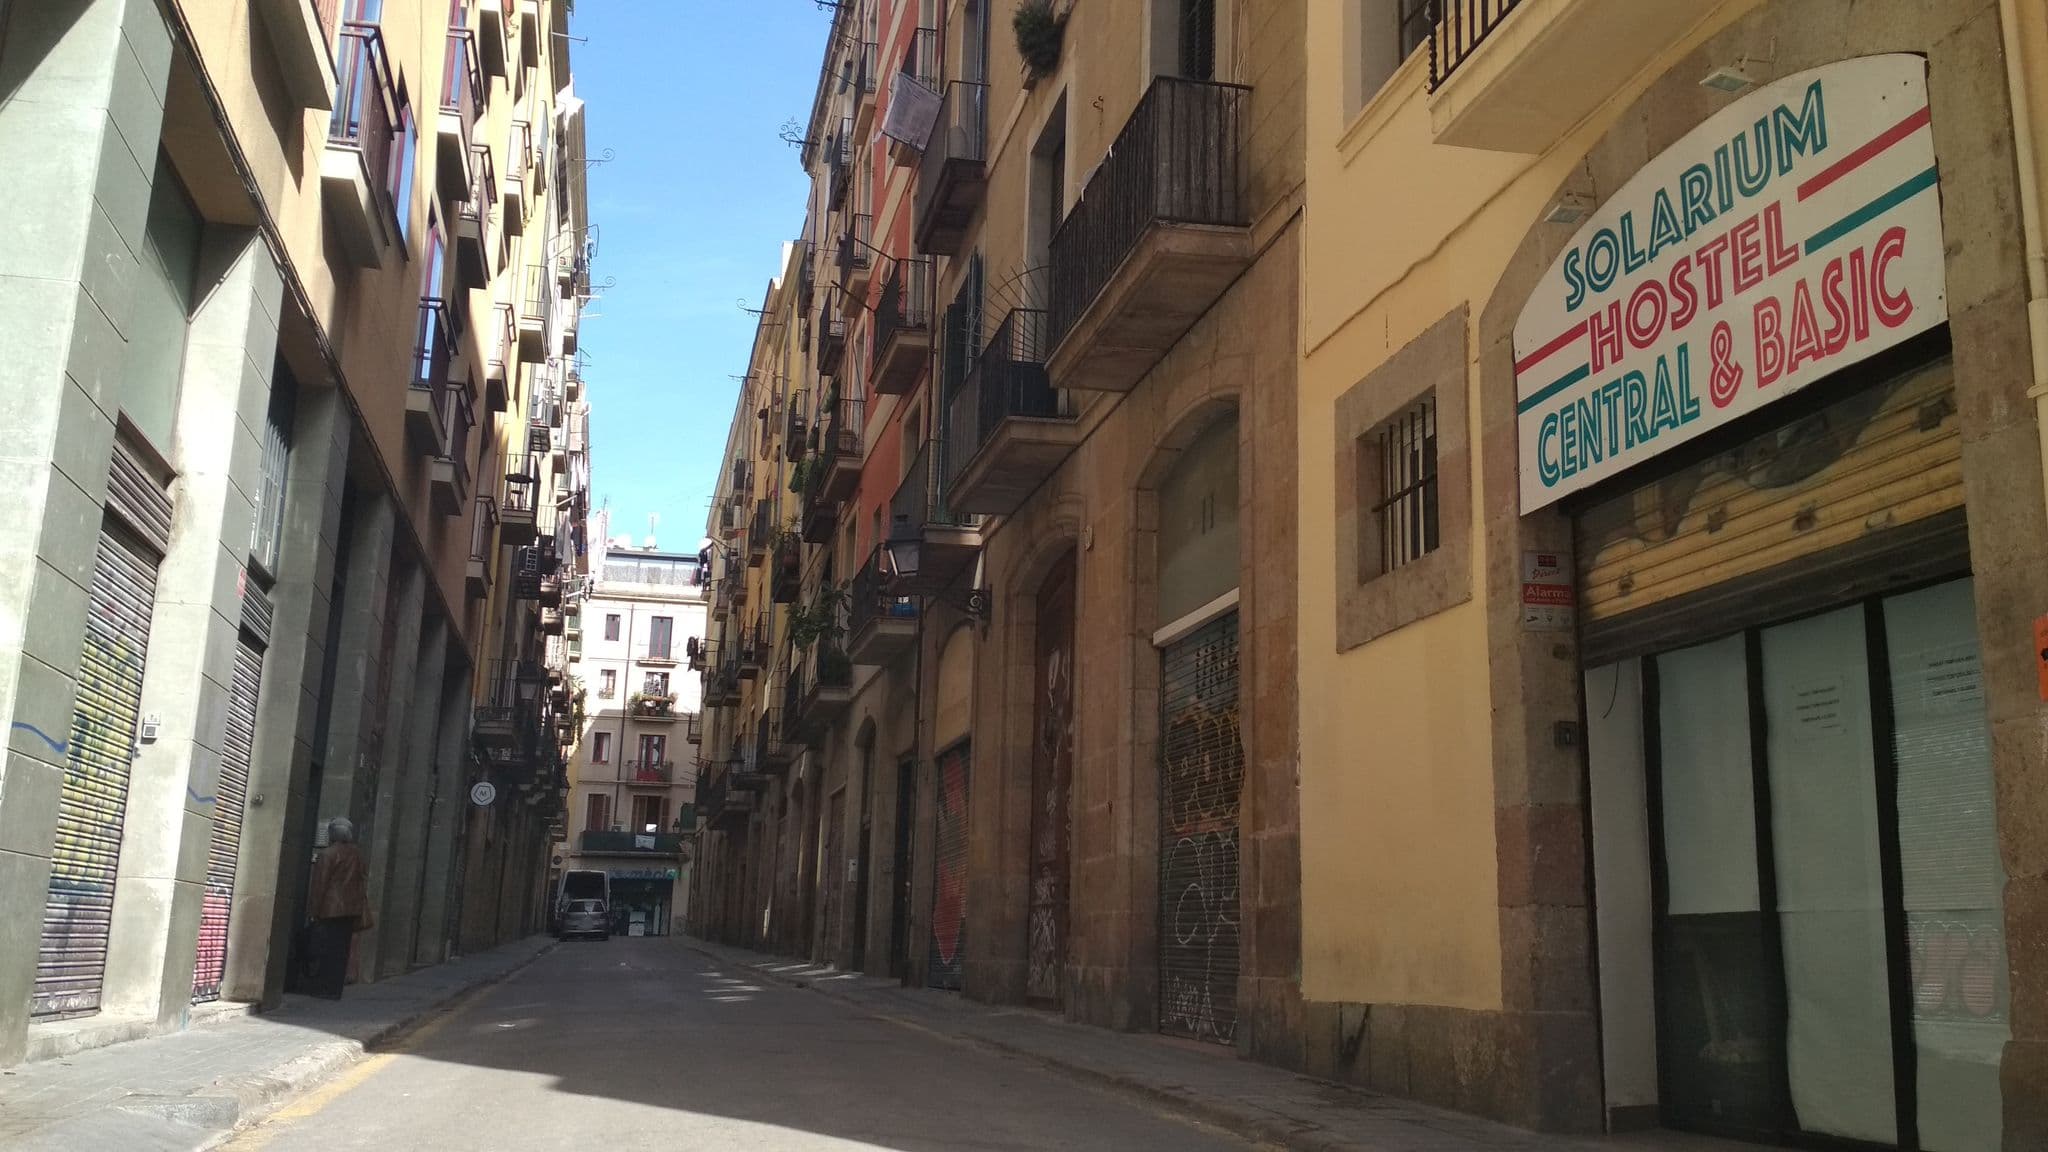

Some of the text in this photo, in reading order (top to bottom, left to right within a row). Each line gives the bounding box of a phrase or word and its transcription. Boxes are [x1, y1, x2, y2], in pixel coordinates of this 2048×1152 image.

[1563, 80, 1828, 312] SOLARIUM
[1588, 201, 1800, 374] HOSTEL
[1537, 226, 1914, 488] CENTRAL & BASIC
